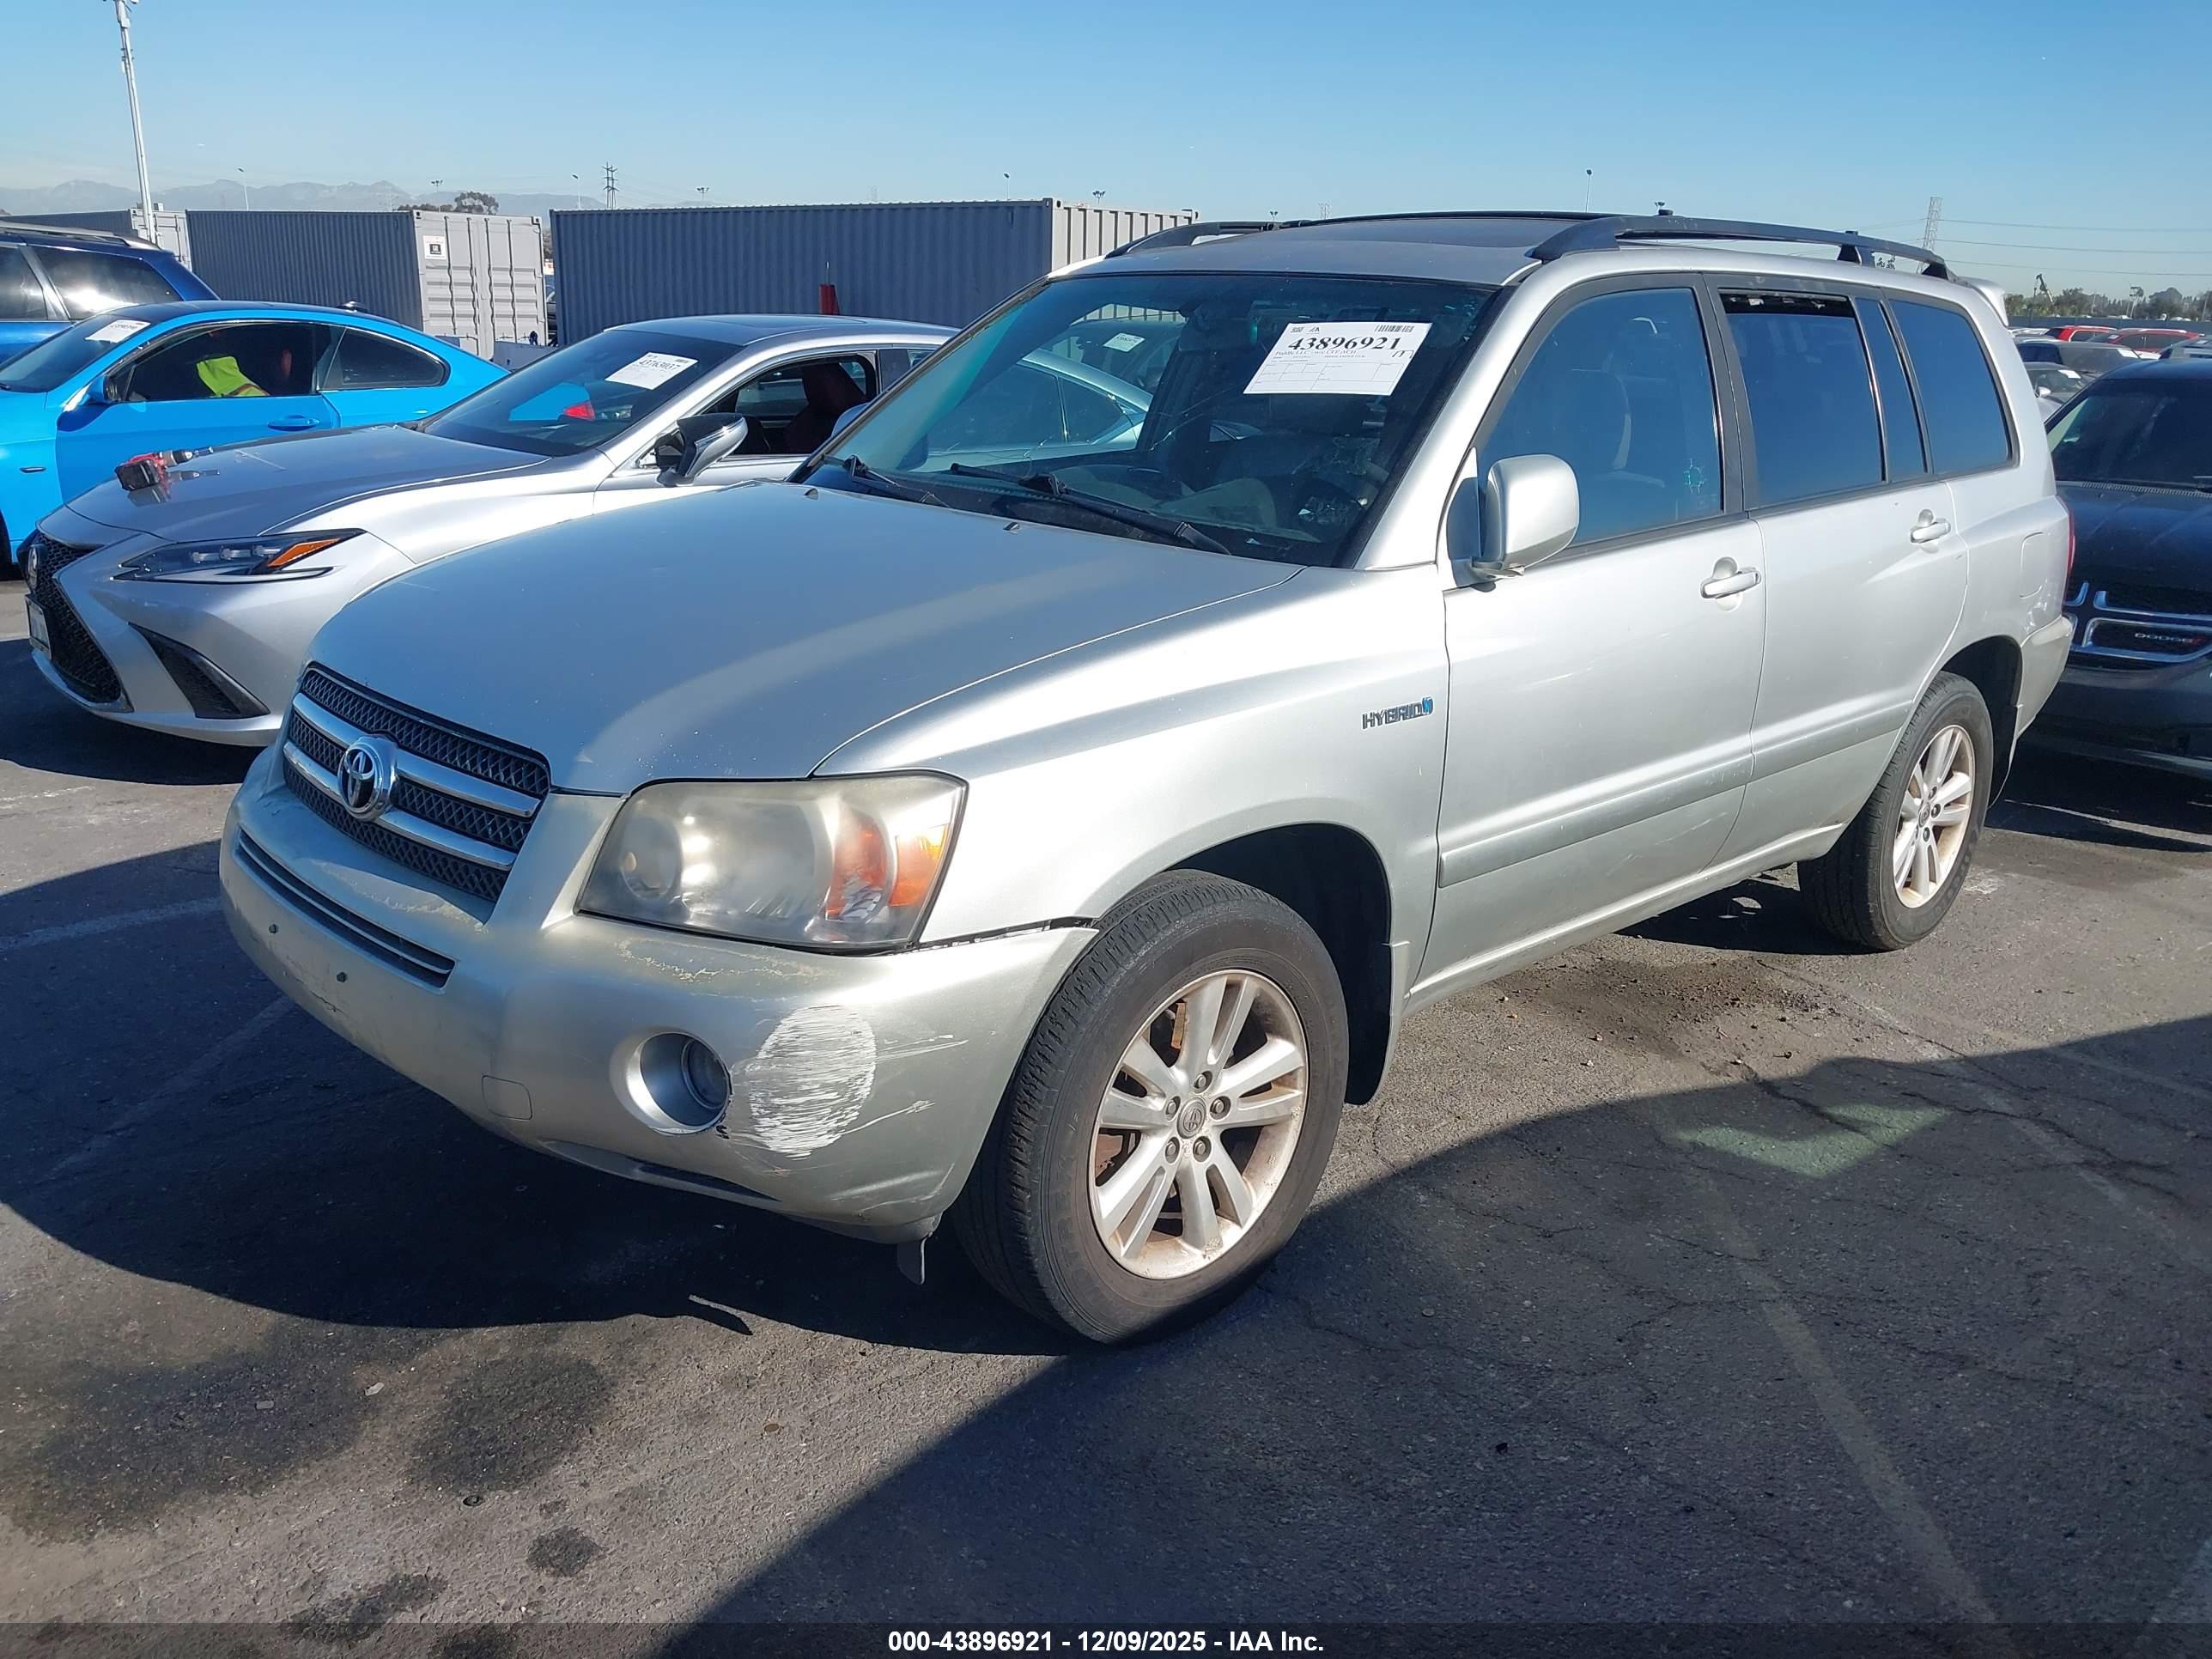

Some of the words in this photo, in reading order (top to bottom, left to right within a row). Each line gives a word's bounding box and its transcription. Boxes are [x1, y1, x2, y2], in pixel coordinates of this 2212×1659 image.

[1288, 337, 1401, 350] 43896921
[2134, 631, 2192, 644] DODGE
[1362, 702, 1422, 730] HYBRID
